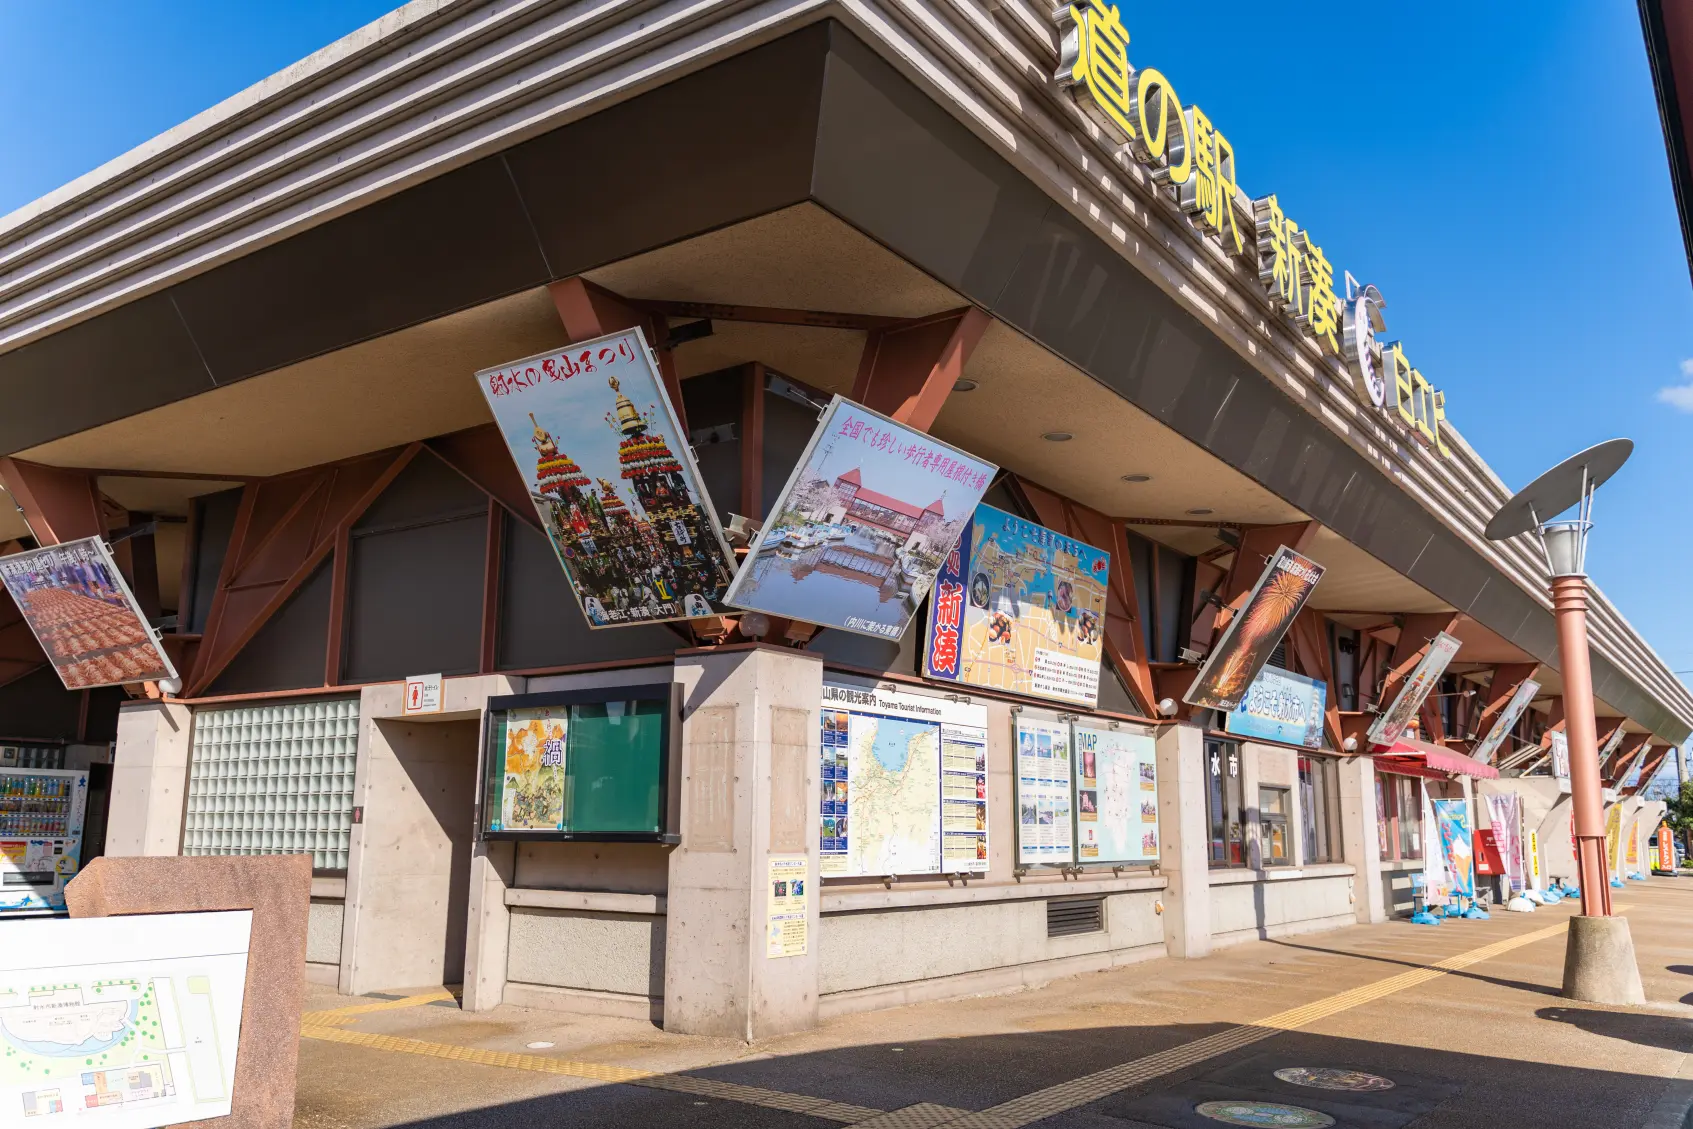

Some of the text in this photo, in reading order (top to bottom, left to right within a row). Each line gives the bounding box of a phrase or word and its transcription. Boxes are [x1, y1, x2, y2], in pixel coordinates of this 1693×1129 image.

[1070, 0, 1243, 256] 道の駅
[1267, 194, 1339, 355] 新湊
[489, 337, 636, 398] 射水の曳山まつり
[838, 415, 988, 492] 全国でも珍しい歩行者専用屋根付き橋
[822, 686, 877, 706] 山県の観光案内
[879, 699, 942, 716] Toyama Tourist Information
